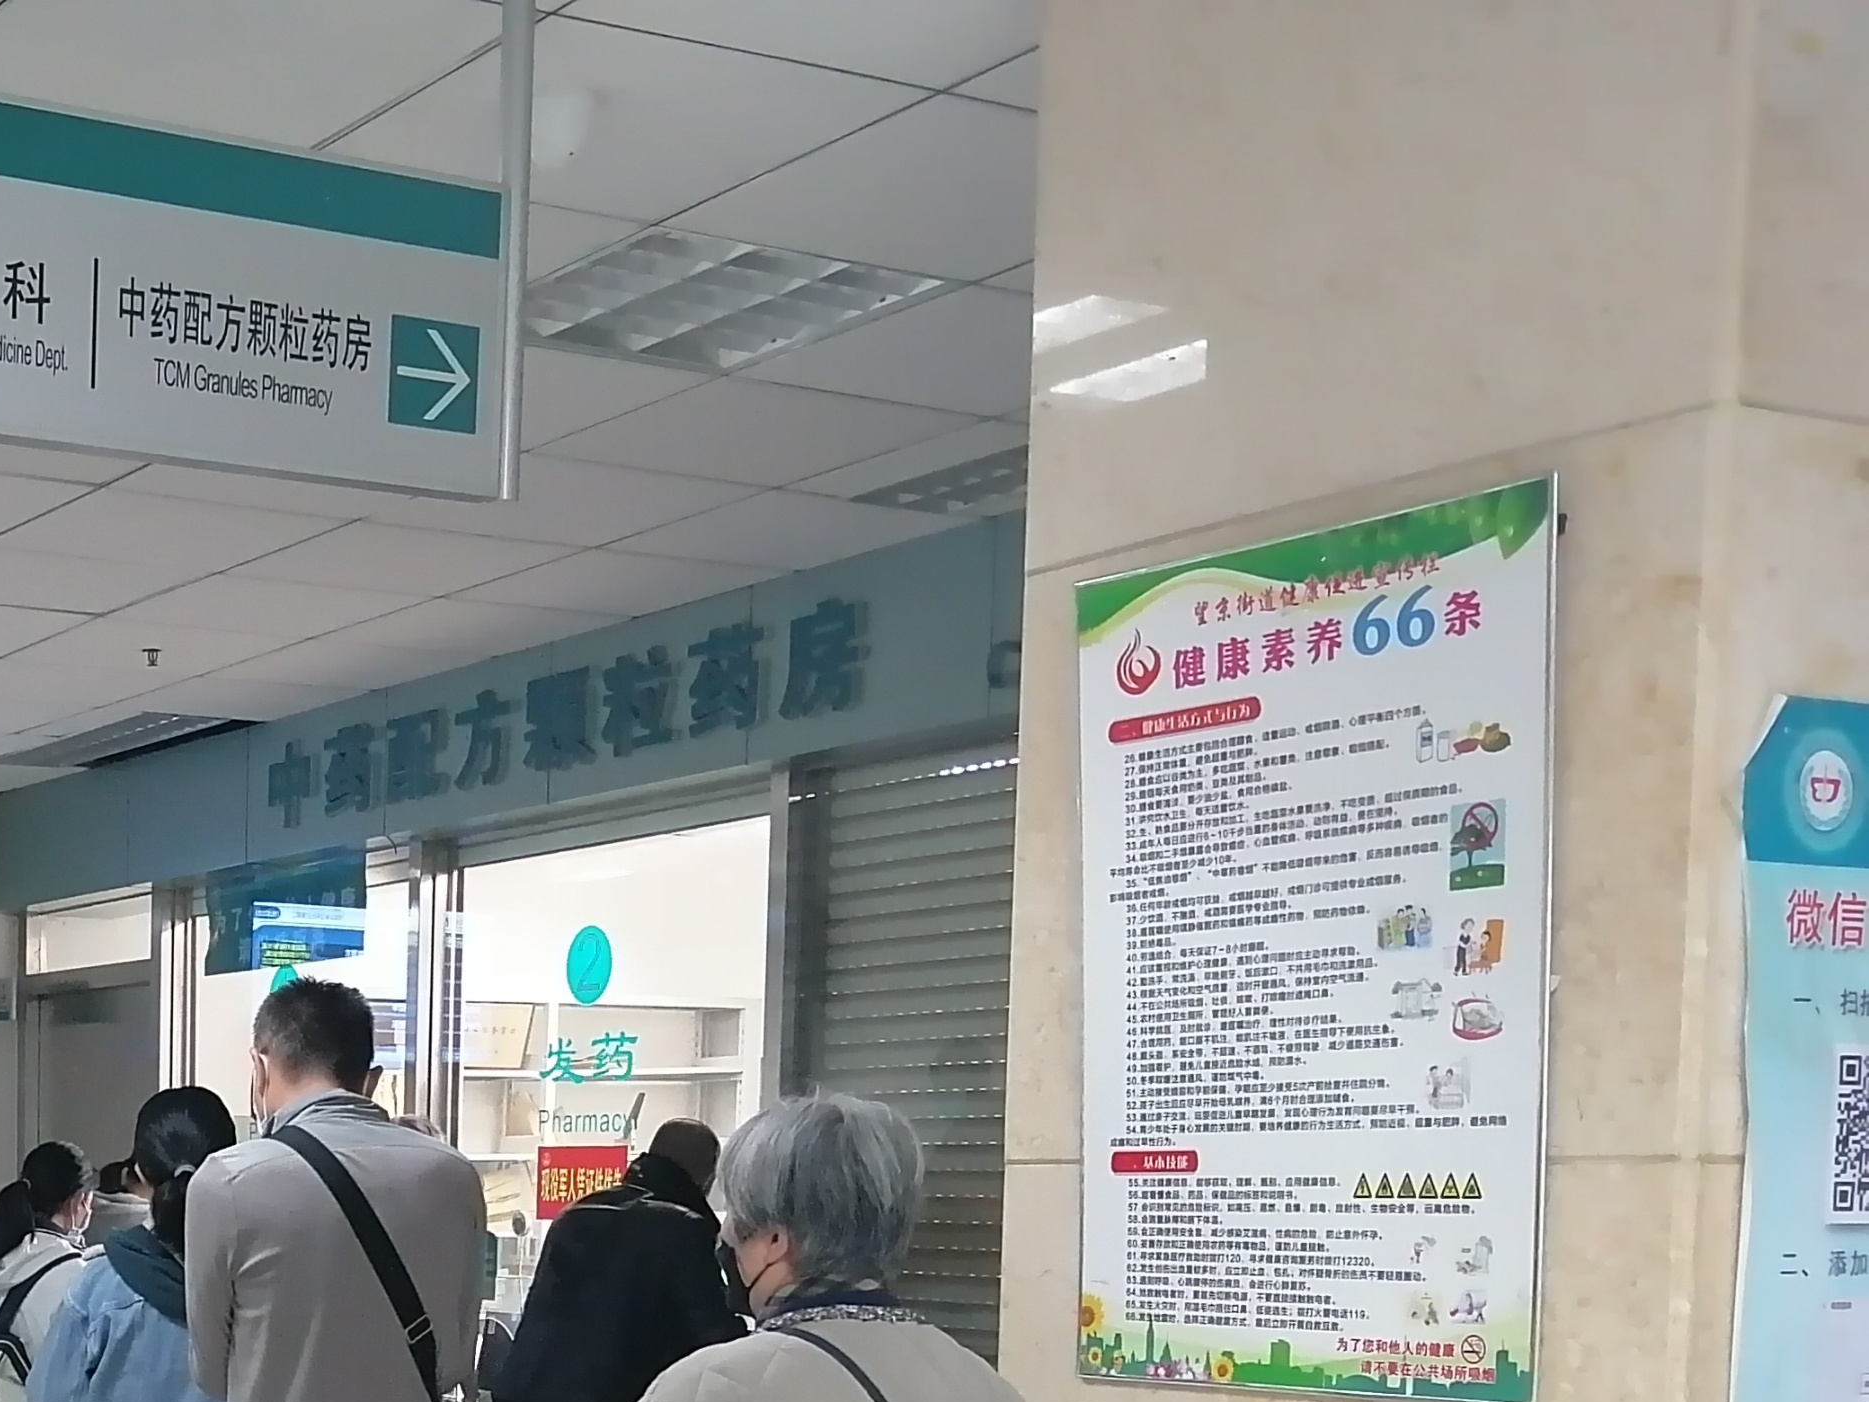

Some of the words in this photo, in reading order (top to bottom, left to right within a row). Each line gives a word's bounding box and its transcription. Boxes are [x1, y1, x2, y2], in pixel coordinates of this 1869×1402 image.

[117, 277, 374, 373] 中药配方颗粒药房
[35, 338, 69, 377] Dept.
[153, 357, 190, 390] TCM
[193, 363, 258, 401] Granules
[261, 373, 333, 415] Pharmacy
[1173, 585, 1481, 690] 健康素养66条
[268, 597, 870, 829] 中药配方颗粒药房
[1786, 889, 1867, 947] 微信
[540, 1031, 638, 1083] 发药
[539, 1110, 634, 1135] Pharmacy
[1124, 1154, 1188, 1170] 、基本技能
[1336, 1336, 1455, 1358] 为了您和他人的健康
[1360, 1359, 1495, 1383] 请不要在公共场所吸烟
